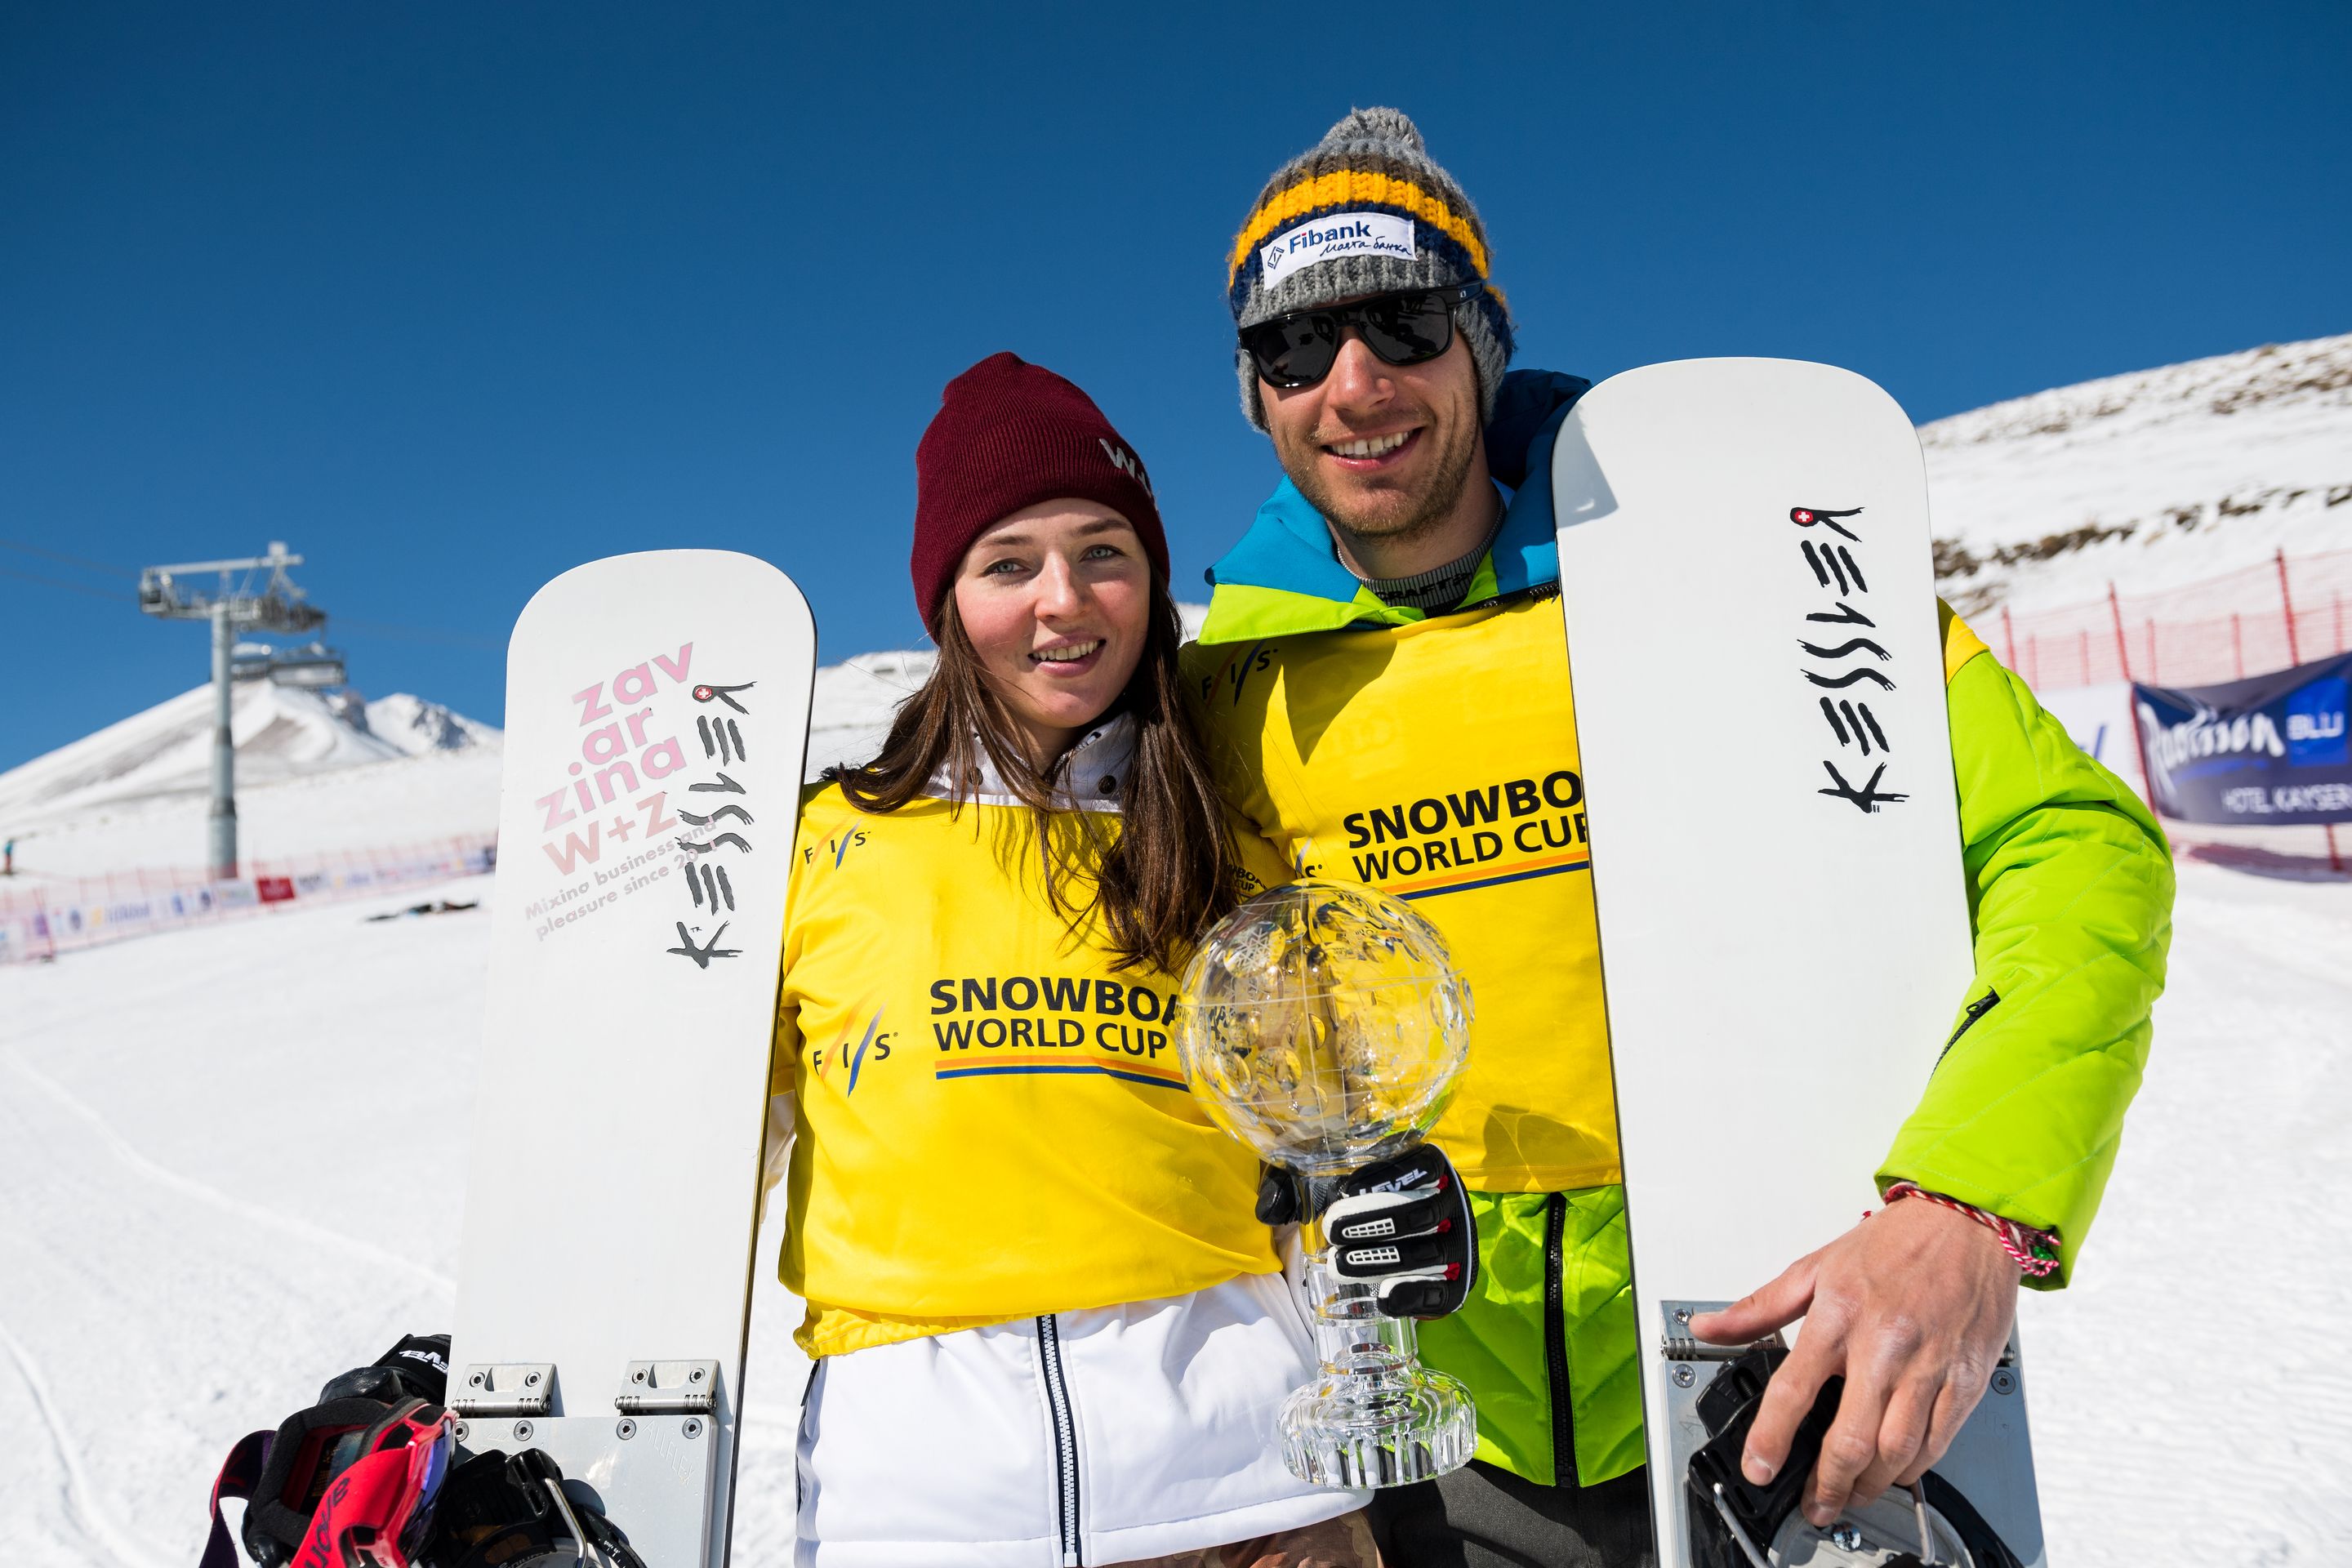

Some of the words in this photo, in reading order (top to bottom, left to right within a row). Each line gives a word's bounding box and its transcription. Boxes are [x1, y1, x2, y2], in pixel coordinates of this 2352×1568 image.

[1290, 221, 1371, 254] Fibank
[572, 642, 693, 727] zav
[2287, 713, 2344, 739] BLU
[535, 736, 687, 833] zina
[542, 791, 678, 876] W+Z
[1352, 831, 1503, 883] WORLD
[594, 840, 675, 886] business
[536, 892, 618, 942] pleasure
[624, 866, 670, 895] since
[933, 1018, 1085, 1052] WORLD
[1096, 1022, 1167, 1058] CUP
